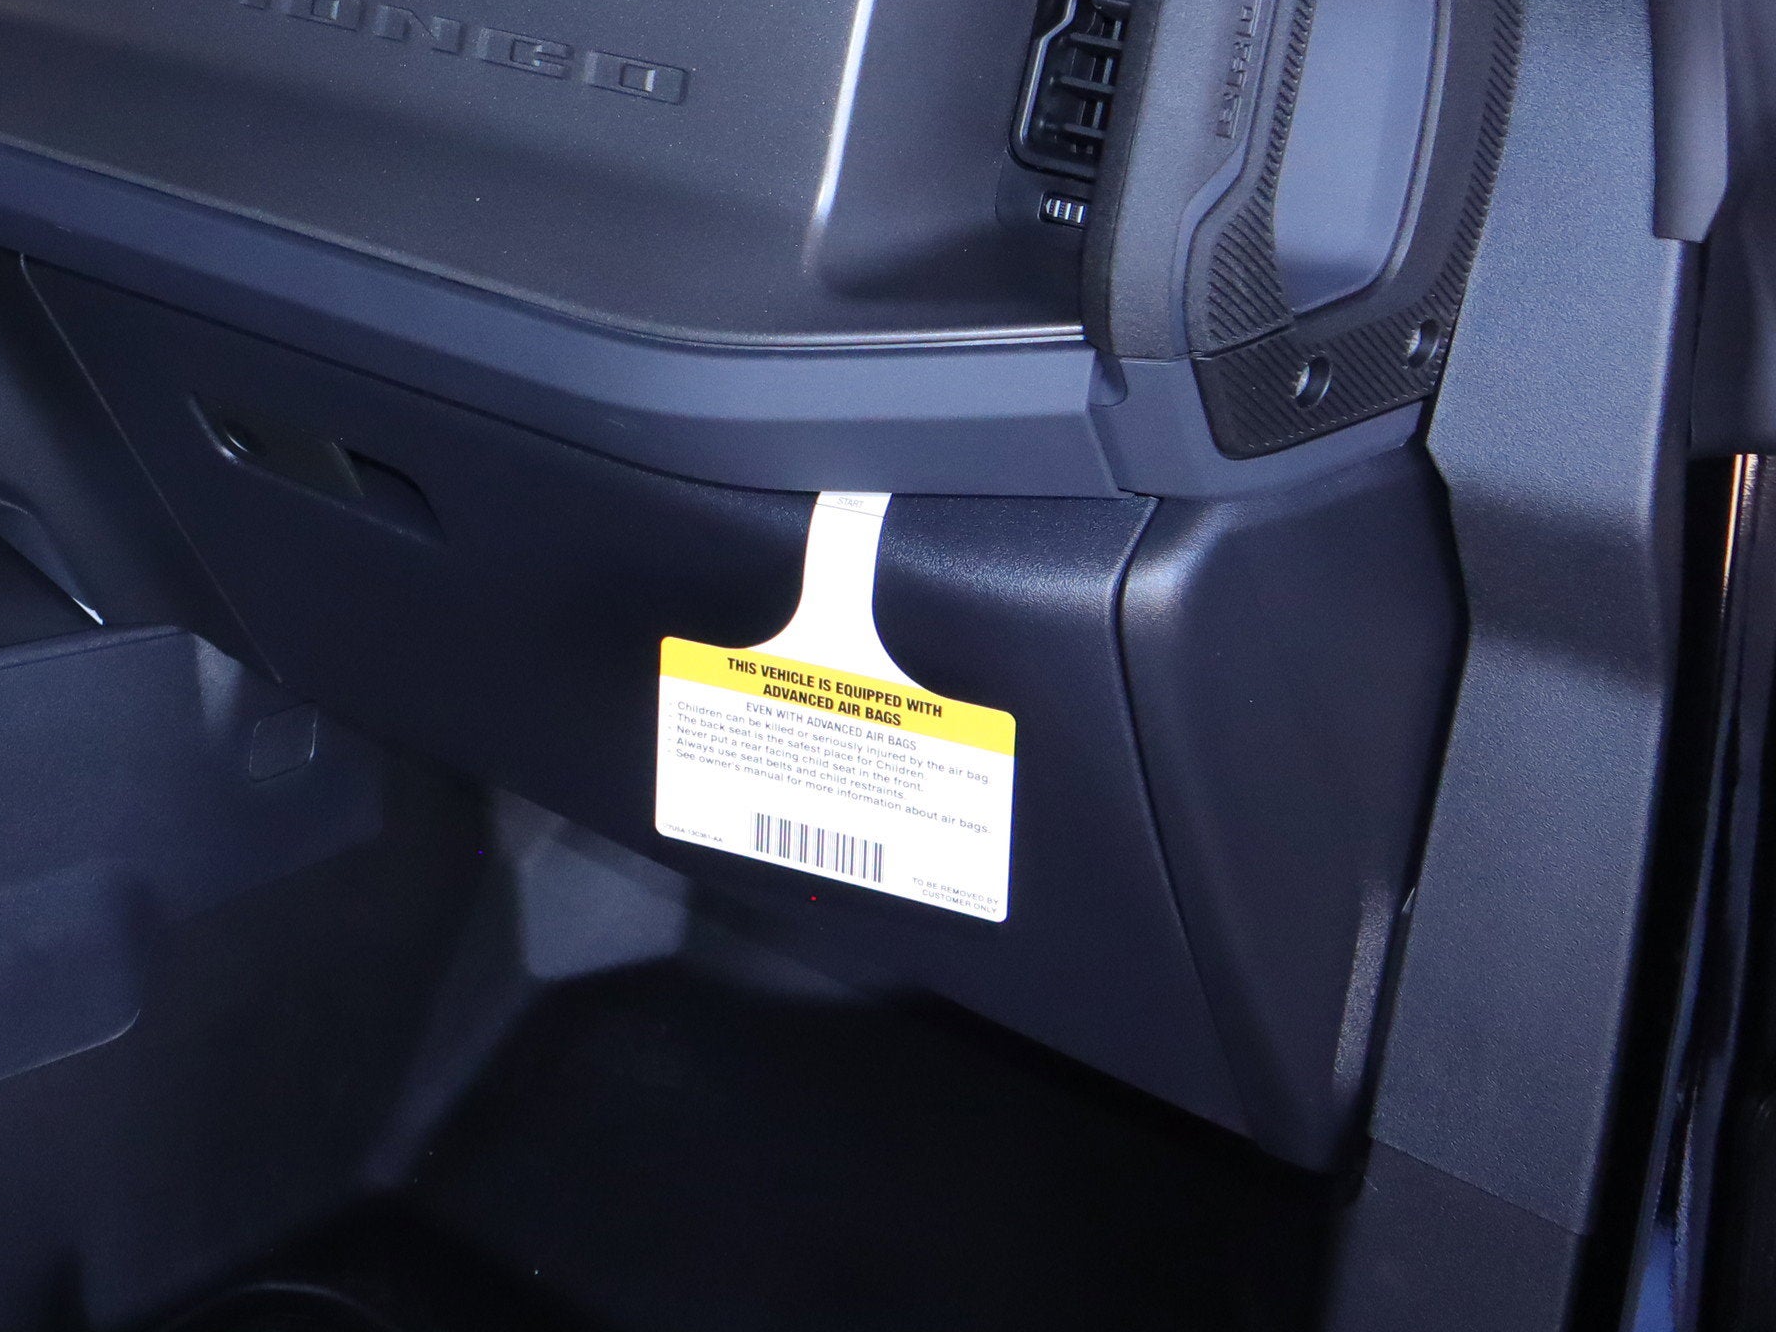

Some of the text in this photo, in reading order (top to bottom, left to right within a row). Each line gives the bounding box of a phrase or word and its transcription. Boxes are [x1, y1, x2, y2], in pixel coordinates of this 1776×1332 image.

[836, 496, 864, 508] START
[727, 657, 943, 717] THIS VEHICLE IS EQUIPPED WITH
[763, 683, 902, 726] ADVANCED AIR BAGS
[677, 701, 723, 718] Children
[726, 713, 745, 723] can
[748, 717, 762, 728] be
[765, 721, 794, 735] killed
[797, 730, 809, 738] or
[812, 733, 863, 754] seriously
[866, 745, 906, 763] injured
[910, 755, 923, 768] by
[927, 760, 945, 772] the
[948, 766, 963, 776] air
[678, 712, 697, 725] The
[700, 719, 725, 731] back
[728, 726, 752, 738] seat
[754, 731, 764, 740] is
[767, 734, 784, 745] the
[787, 740, 821, 754] safest
[823, 748, 854, 762] place
[856, 755, 873, 766] for
[746, 702, 917, 751] EVEN WITH ADVANCED AIR BAGS
[676, 725, 708, 739] Never
[710, 733, 729, 745] put
[731, 738, 738, 747] a
[740, 740, 762, 752] rear
[765, 745, 799, 763] facing
[802, 755, 829, 768] child
[832, 763, 856, 775] seat
[859, 768, 869, 778] in
[873, 771, 891, 783] the
[676, 737, 715, 753] Always
[718, 748, 738, 758] use
[740, 753, 763, 764] seat
[766, 758, 793, 772] belts
[796, 766, 817, 778] and
[819, 772, 847, 785] child
[676, 748, 991, 834] See owner's manual for more information about air bags.
[912, 876, 999, 906] TO BE REMOVED BY
[922, 888, 997, 914] CUSTOMER ONLY
